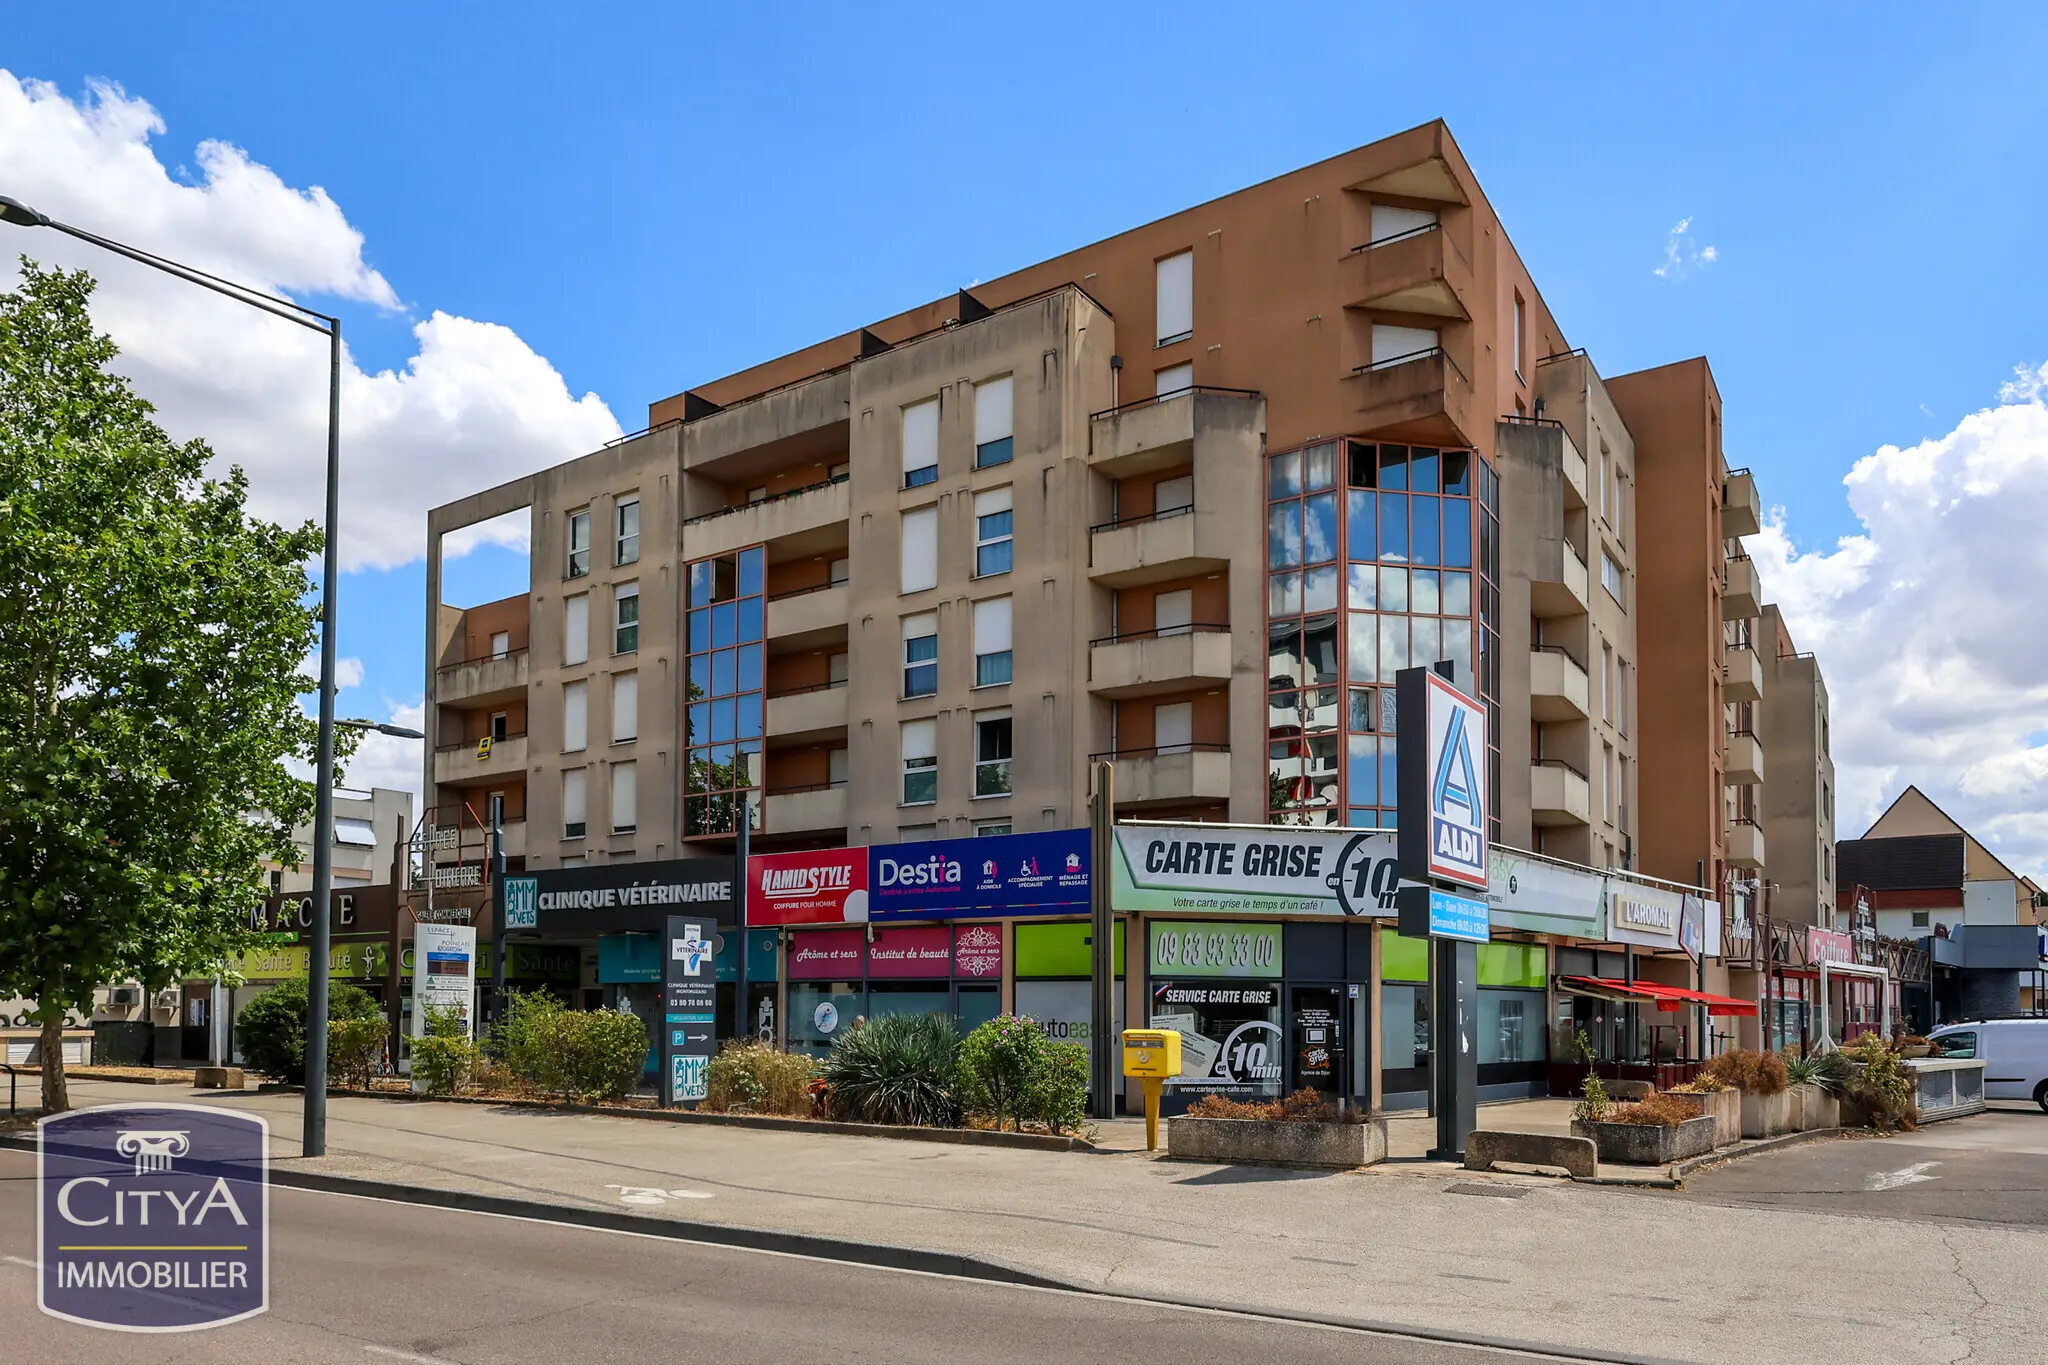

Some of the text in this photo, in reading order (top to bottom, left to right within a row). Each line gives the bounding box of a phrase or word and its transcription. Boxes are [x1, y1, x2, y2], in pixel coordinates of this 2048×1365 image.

[1438, 824, 1478, 865] ALDI
[1145, 840, 1323, 878] CARTE GRISE
[879, 854, 962, 887] Destia
[1007, 875, 1054, 884] ACCOMPAGNEMENT
[1327, 877, 1340, 887] en
[538, 880, 732, 911] CLINIQUE VÉTÉRINAIRE
[773, 902, 799, 910] COIFFURE
[815, 900, 837, 908] HOMME
[1173, 897, 1193, 910] Votre
[1196, 900, 1217, 909] carte
[1220, 899, 1240, 911] grise
[1242, 899, 1251, 909] le
[1253, 901, 1278, 912] temps
[1280, 899, 1299, 910] d'un
[1300, 901, 1318, 911] café
[516, 910, 534, 924] VETS
[796, 948, 858, 963] Arôme et sens
[870, 947, 949, 960] Institut de beauté
[1157, 931, 1275, 968] 09 83 93 33 00
[1813, 938, 1849, 963] Coiffure
[255, 954, 292, 972] Santé
[670, 999, 678, 1007] 03
[1165, 989, 1272, 1004] SERVICE CARTE GRISE
[1233, 1042, 1267, 1072] 10
[1251, 1063, 1282, 1078] min
[685, 1085, 704, 1096] VETS
